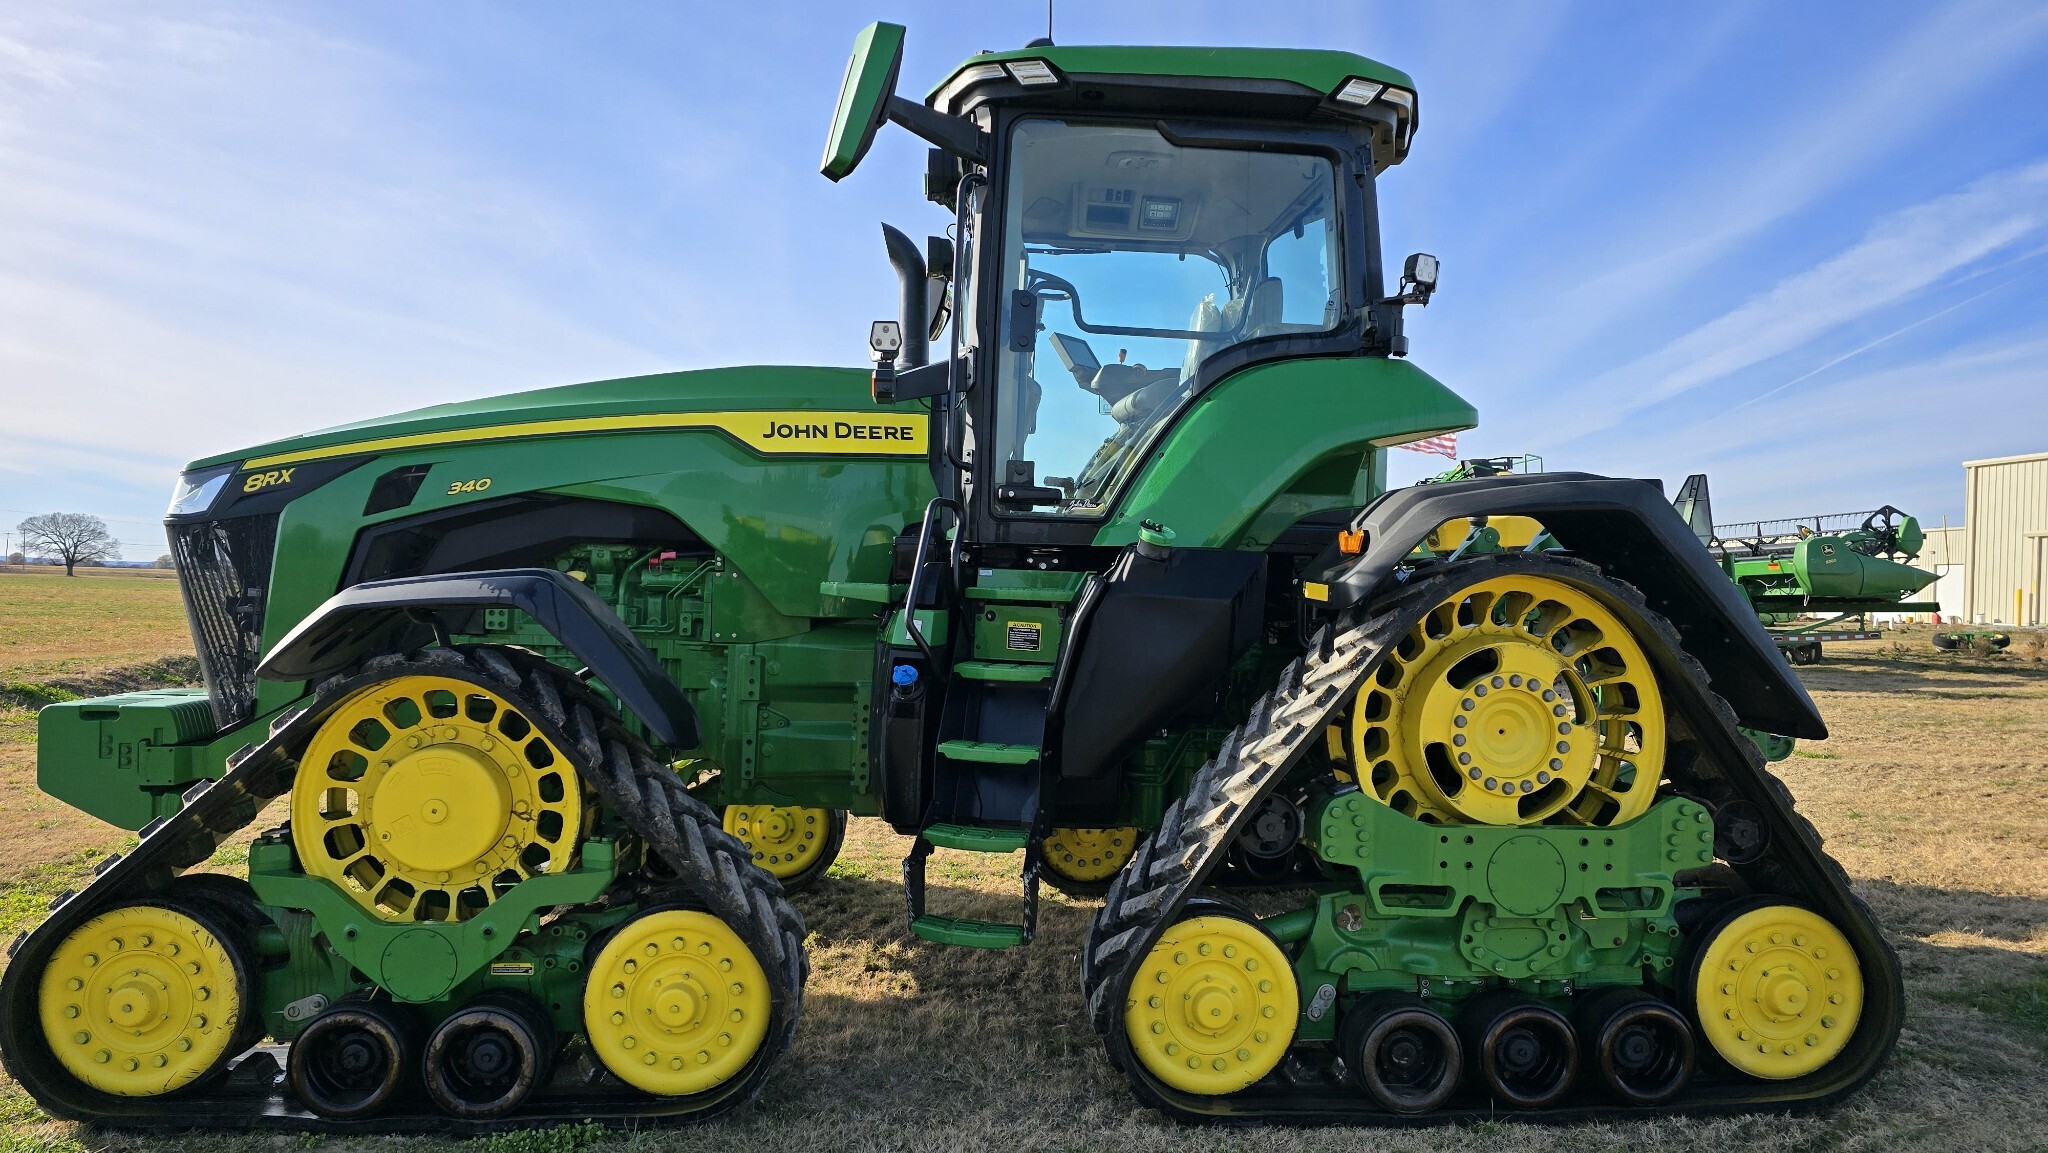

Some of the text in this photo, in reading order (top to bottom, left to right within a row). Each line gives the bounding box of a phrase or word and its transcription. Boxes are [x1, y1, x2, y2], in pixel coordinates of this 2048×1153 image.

[763, 421, 914, 440] JOHN DEERE
[243, 467, 296, 492] 8RX
[446, 477, 492, 495] 340
